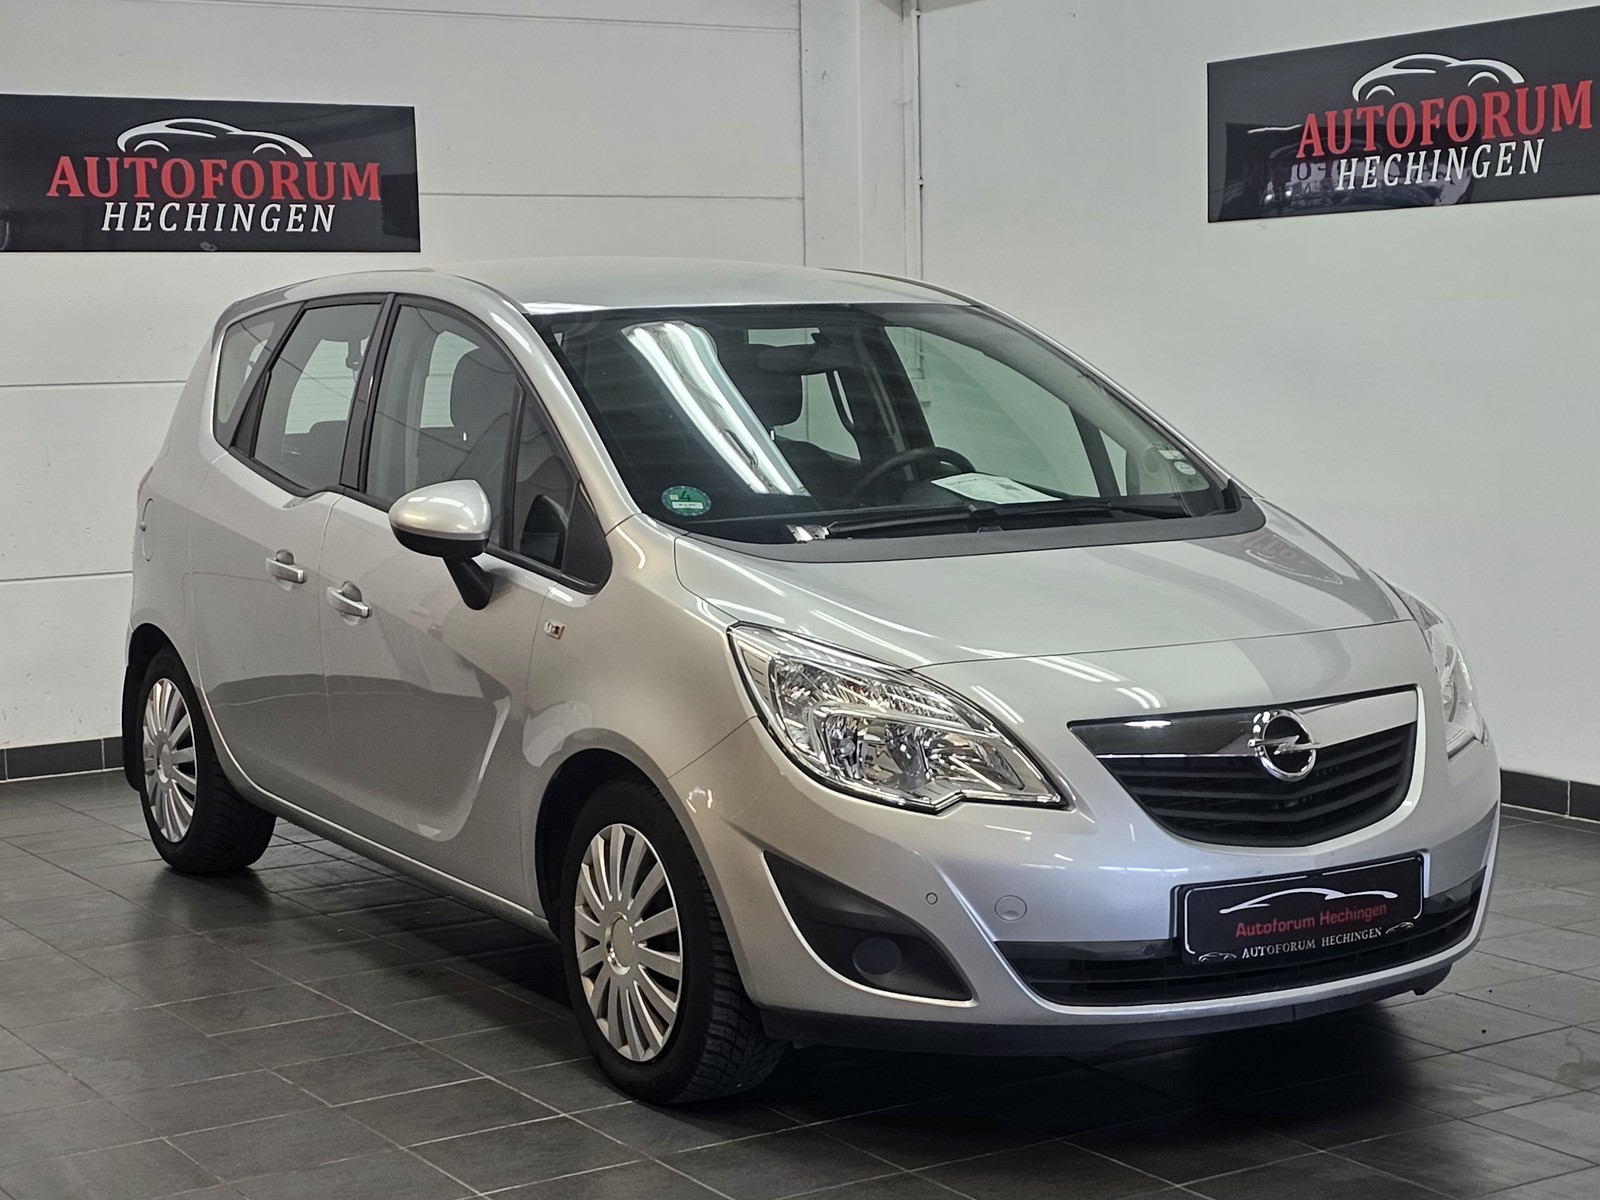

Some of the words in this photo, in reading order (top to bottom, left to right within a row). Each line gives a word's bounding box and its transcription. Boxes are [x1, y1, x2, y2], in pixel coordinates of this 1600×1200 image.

[1296, 80, 1593, 158] AUTOFORUM
[46, 156, 381, 201] AUTOFORUM
[1335, 139, 1545, 191] HECHINGEN
[101, 202, 335, 233] HECHINGEN
[680, 490, 691, 501] 4
[1235, 915, 1316, 938] Autoforum
[1319, 903, 1387, 926] Hechingen
[1241, 938, 1316, 959] AUTOFORUM
[1321, 926, 1383, 947] HECHINGEN
